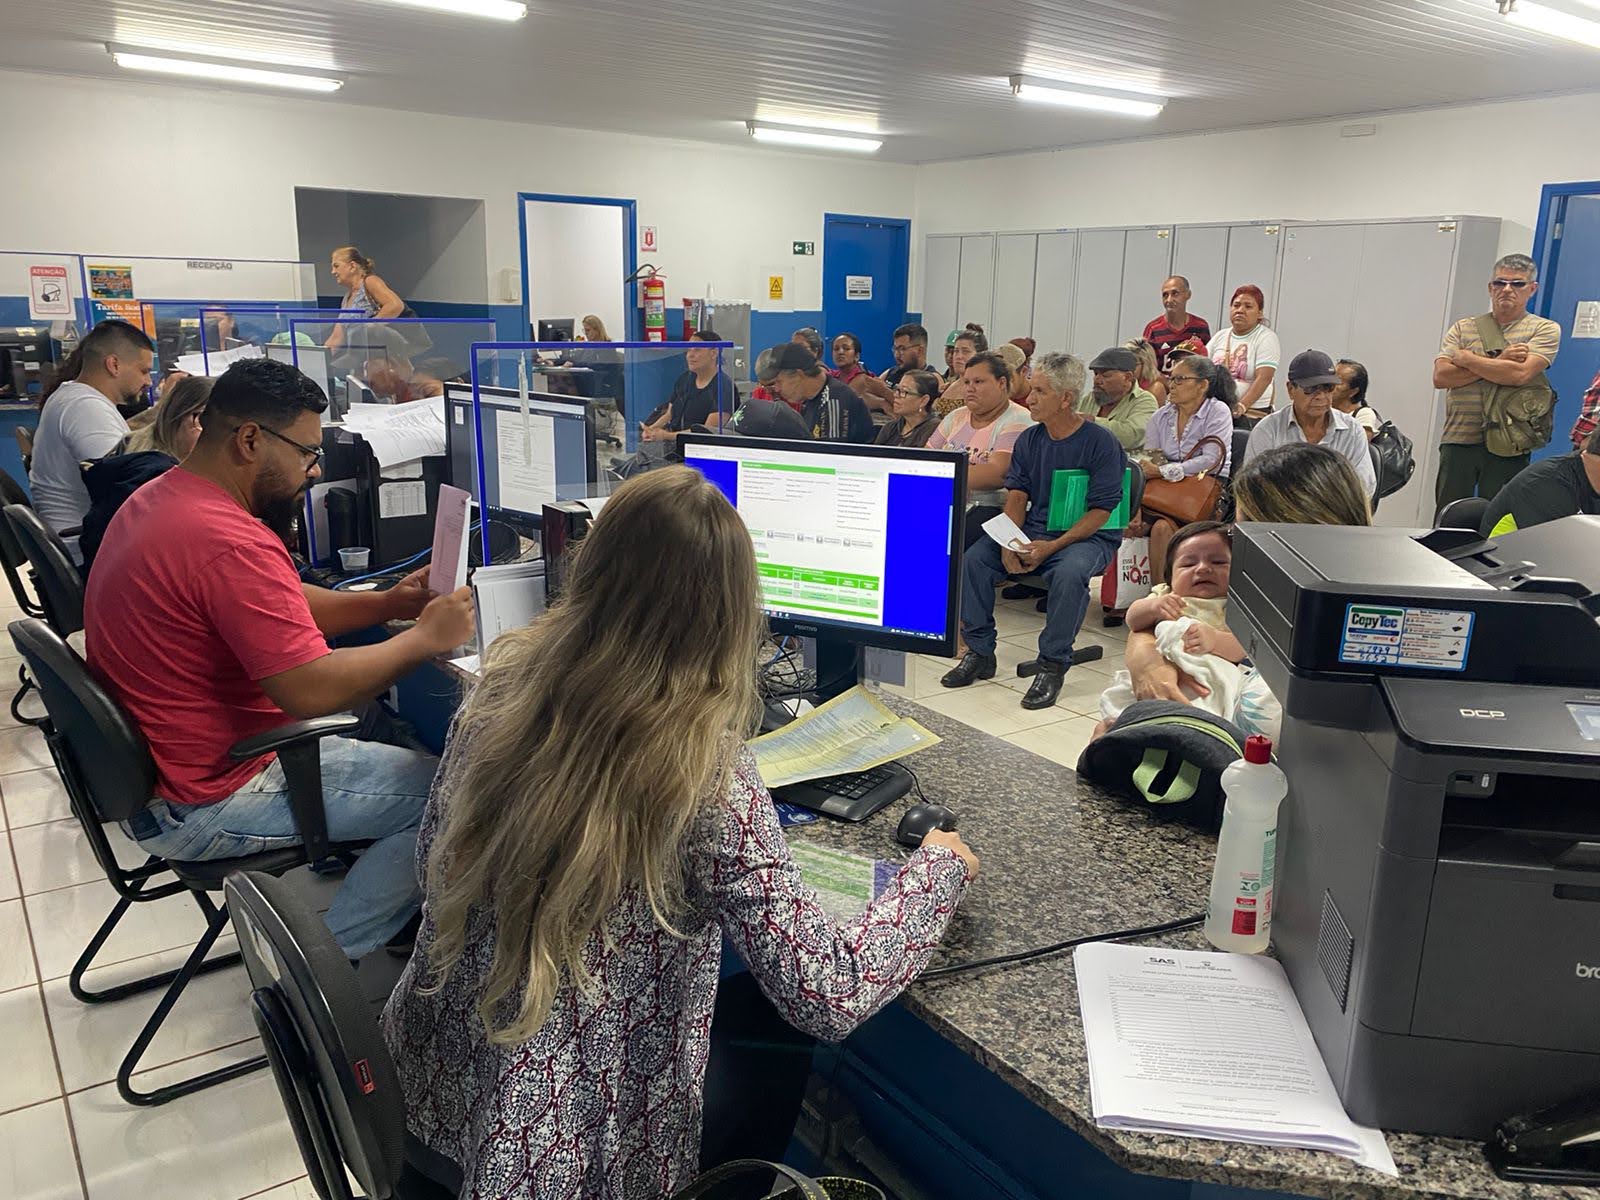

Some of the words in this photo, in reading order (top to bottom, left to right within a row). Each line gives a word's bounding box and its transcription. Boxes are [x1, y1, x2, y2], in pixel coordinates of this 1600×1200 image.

[187, 260, 232, 270] RECEPÇÃO
[96, 303, 123, 311] Tarifa
[1352, 613, 1398, 628] CopyTec
[1460, 708, 1505, 719] DCP
[1148, 956, 1176, 965] SAS
